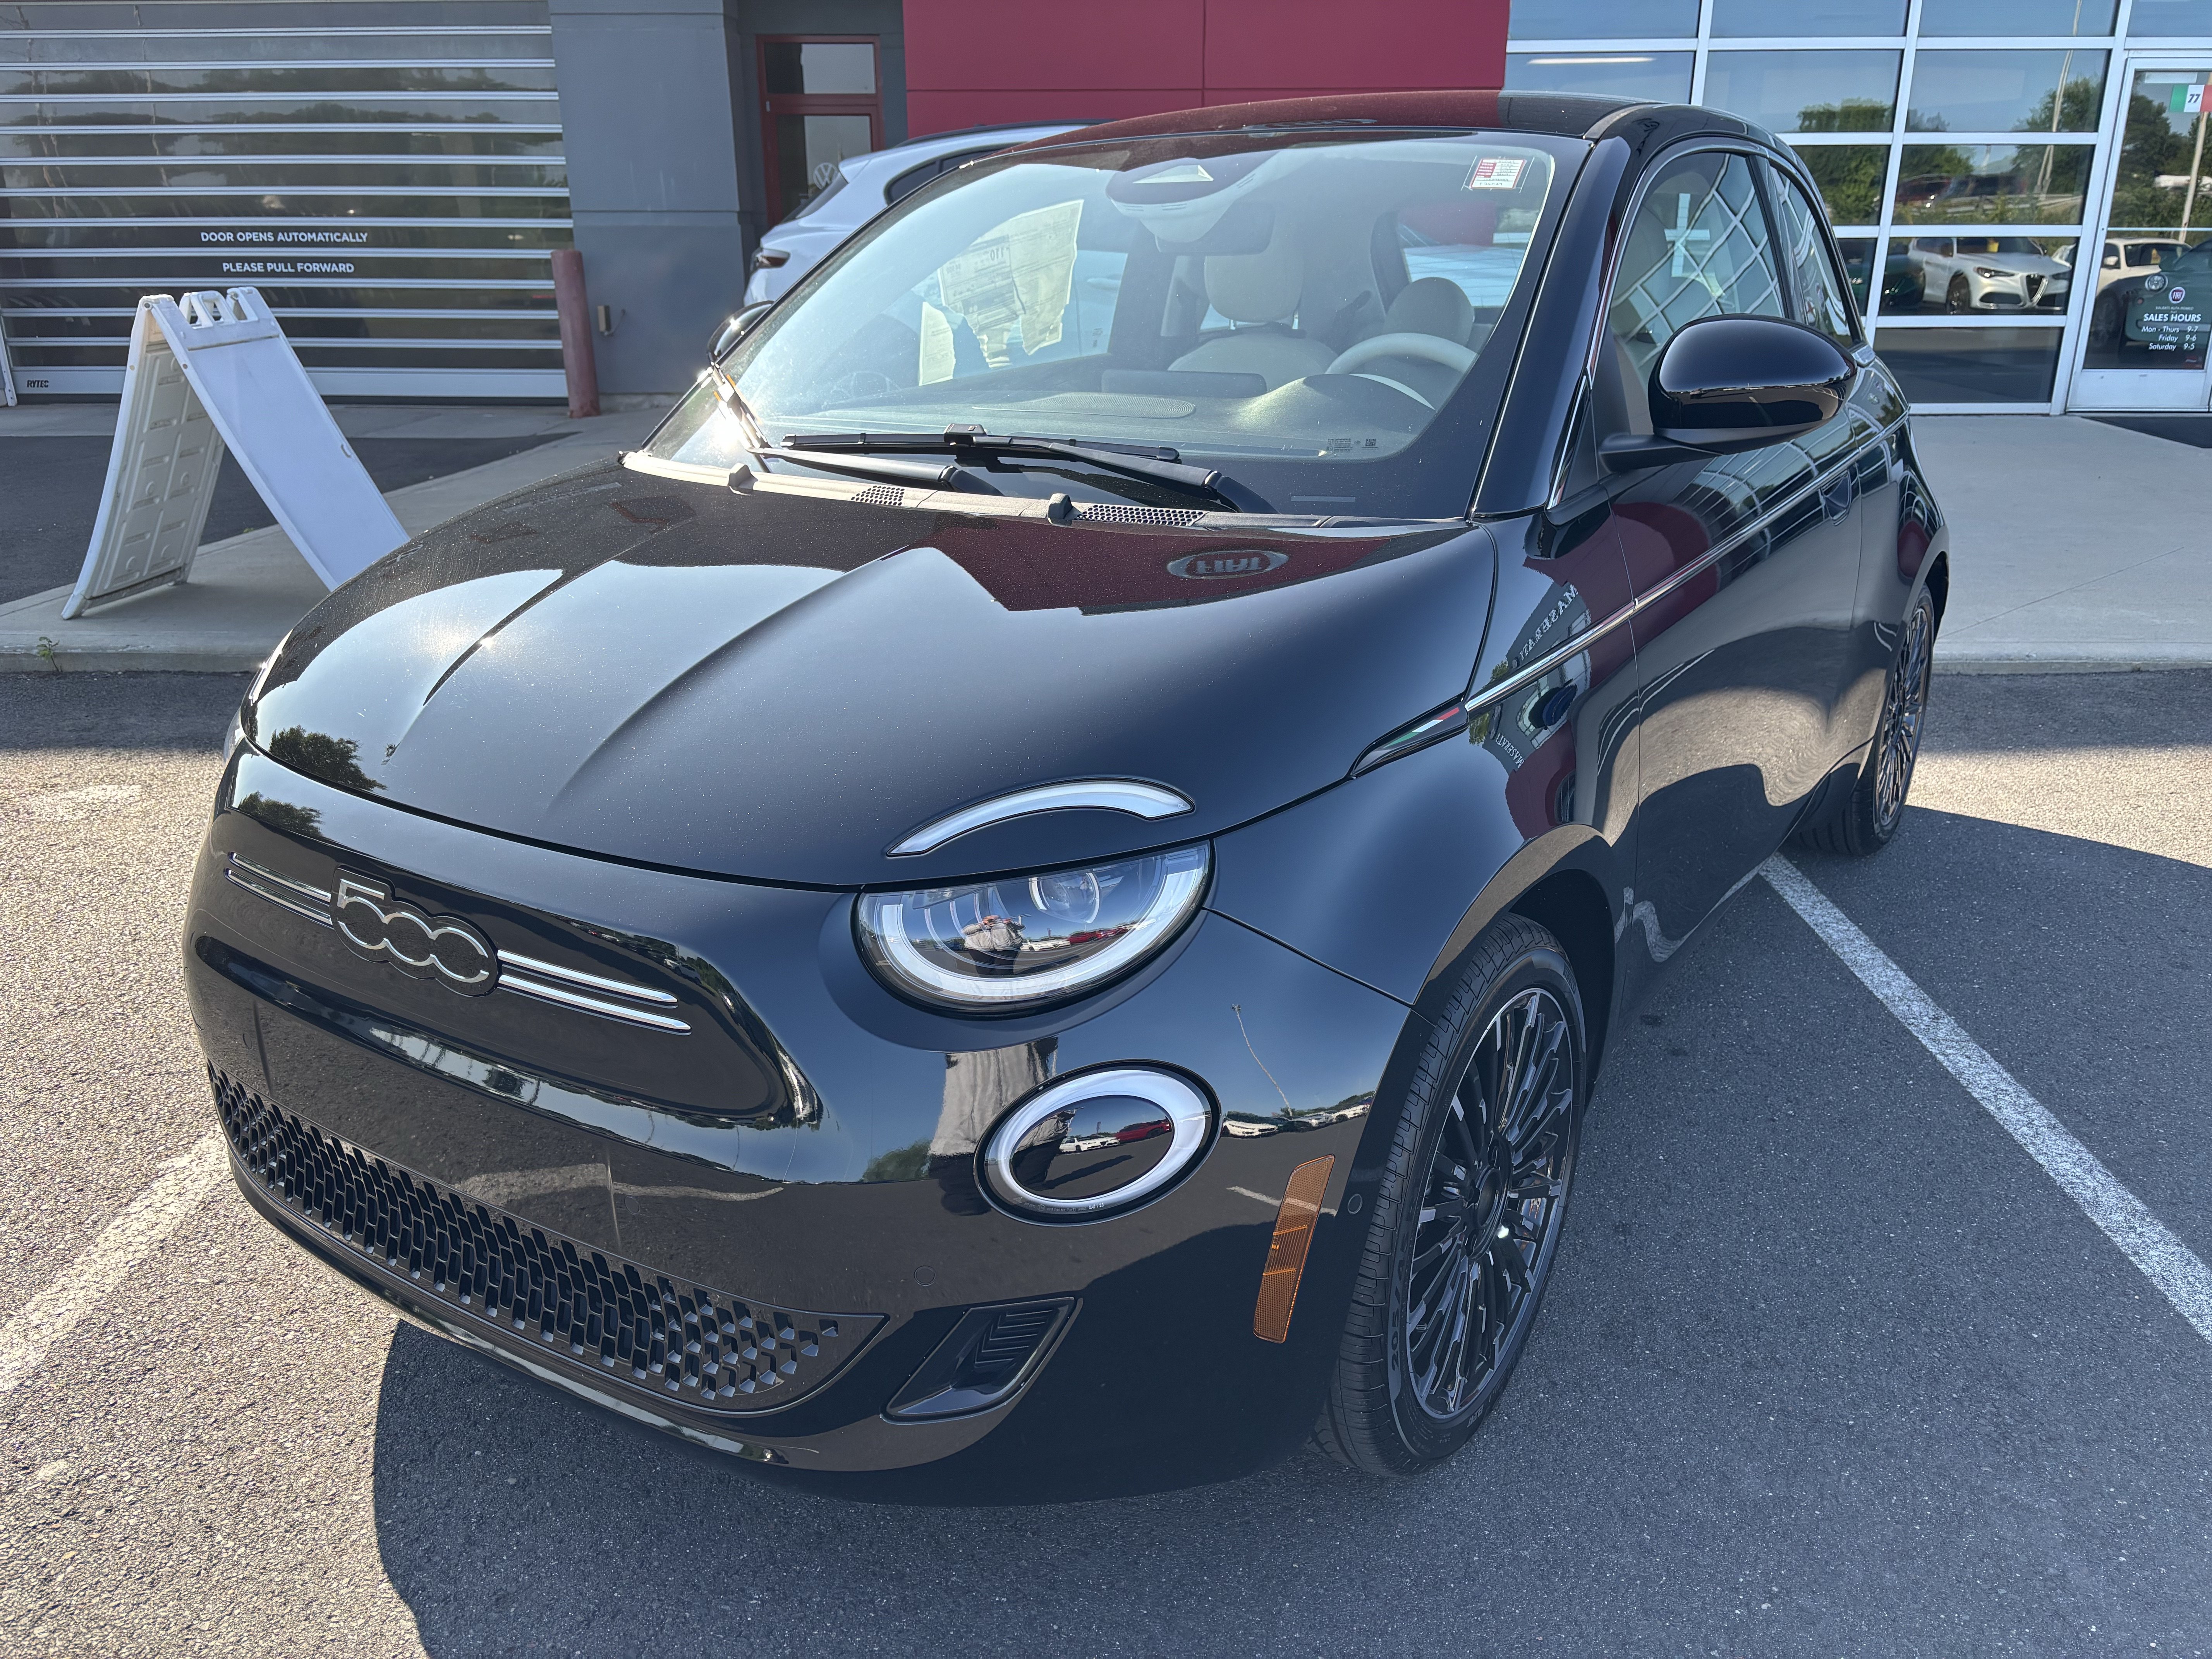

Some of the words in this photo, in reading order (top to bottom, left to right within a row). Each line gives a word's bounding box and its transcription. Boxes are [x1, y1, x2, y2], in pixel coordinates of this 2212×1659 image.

[2188, 94, 2201, 103] 77
[200, 232, 234, 242] DOOR
[237, 232, 274, 242] OPENS
[277, 232, 368, 242] AUTOMATICALLY
[222, 263, 264, 272] PLEASE
[267, 263, 295, 272] PULL
[297, 263, 354, 273] FORWARD
[2143, 313, 2169, 322] SALES
[2170, 314, 2202, 322] HOURS
[2158, 334, 2178, 342] Friday
[2148, 342, 2177, 351] Saturday
[337, 878, 489, 983] 500
